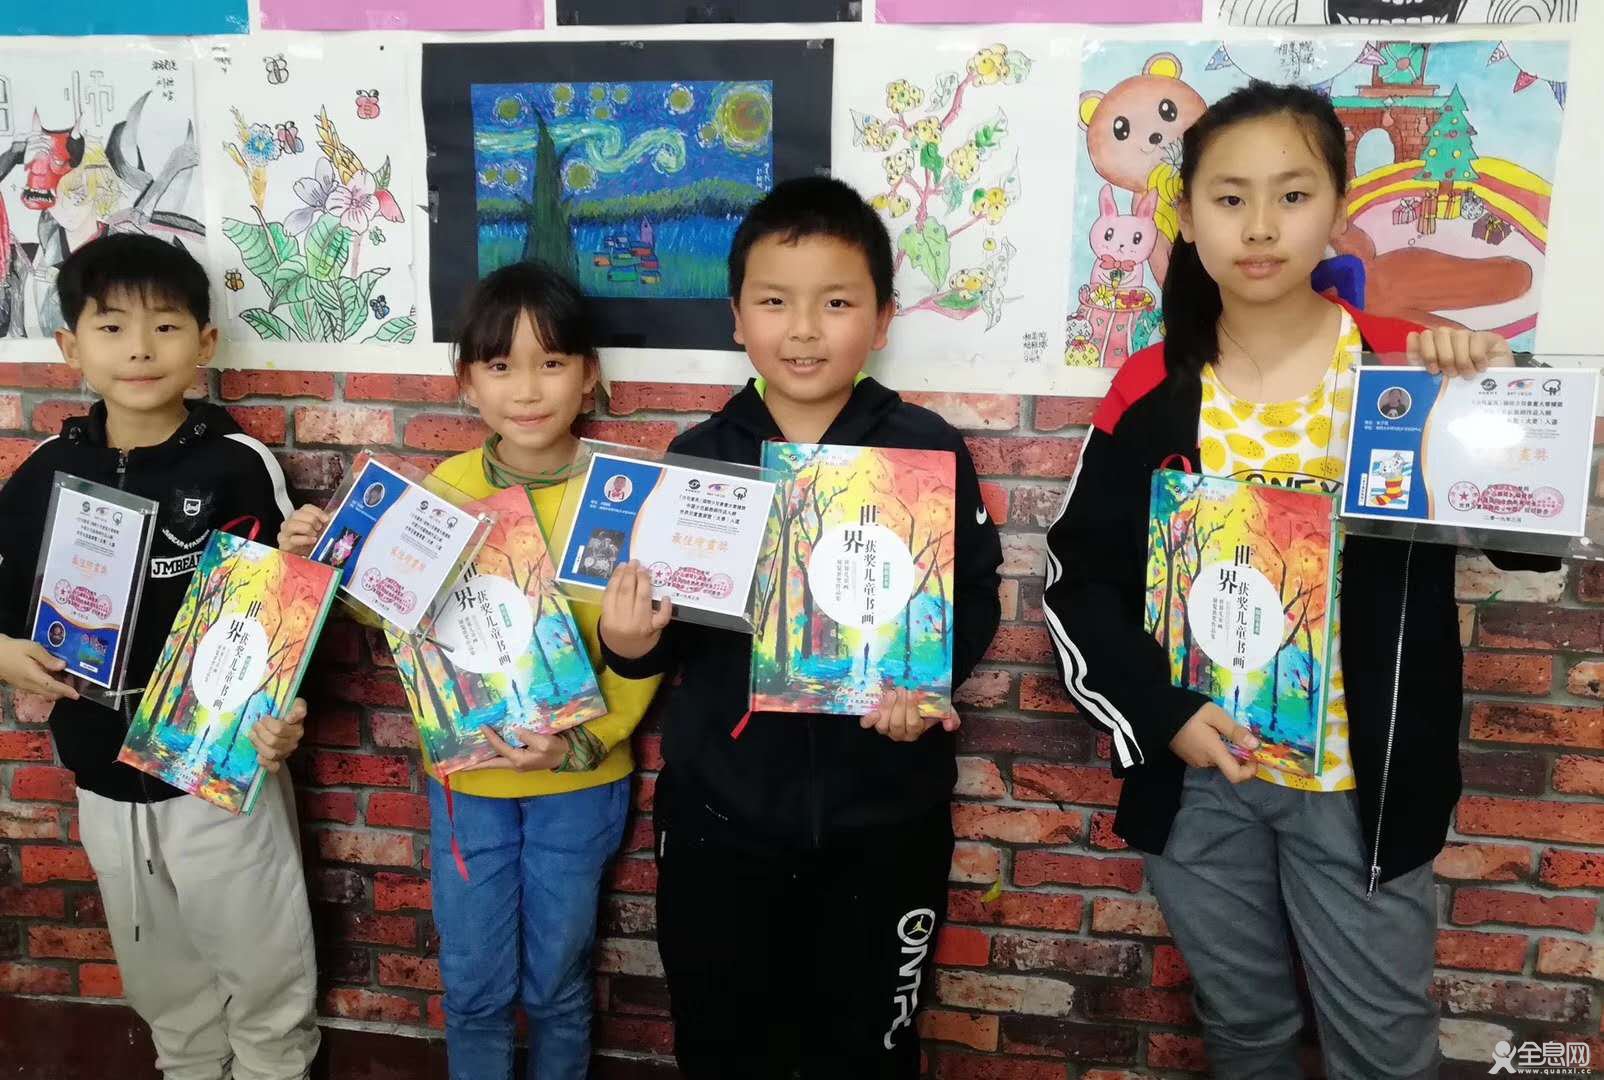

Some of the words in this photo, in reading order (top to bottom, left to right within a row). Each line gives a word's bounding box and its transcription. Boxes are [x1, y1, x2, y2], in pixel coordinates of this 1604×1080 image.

[861, 538, 878, 625] 获奖儿童书画
[1232, 582, 1250, 669] 获奖儿童书画
